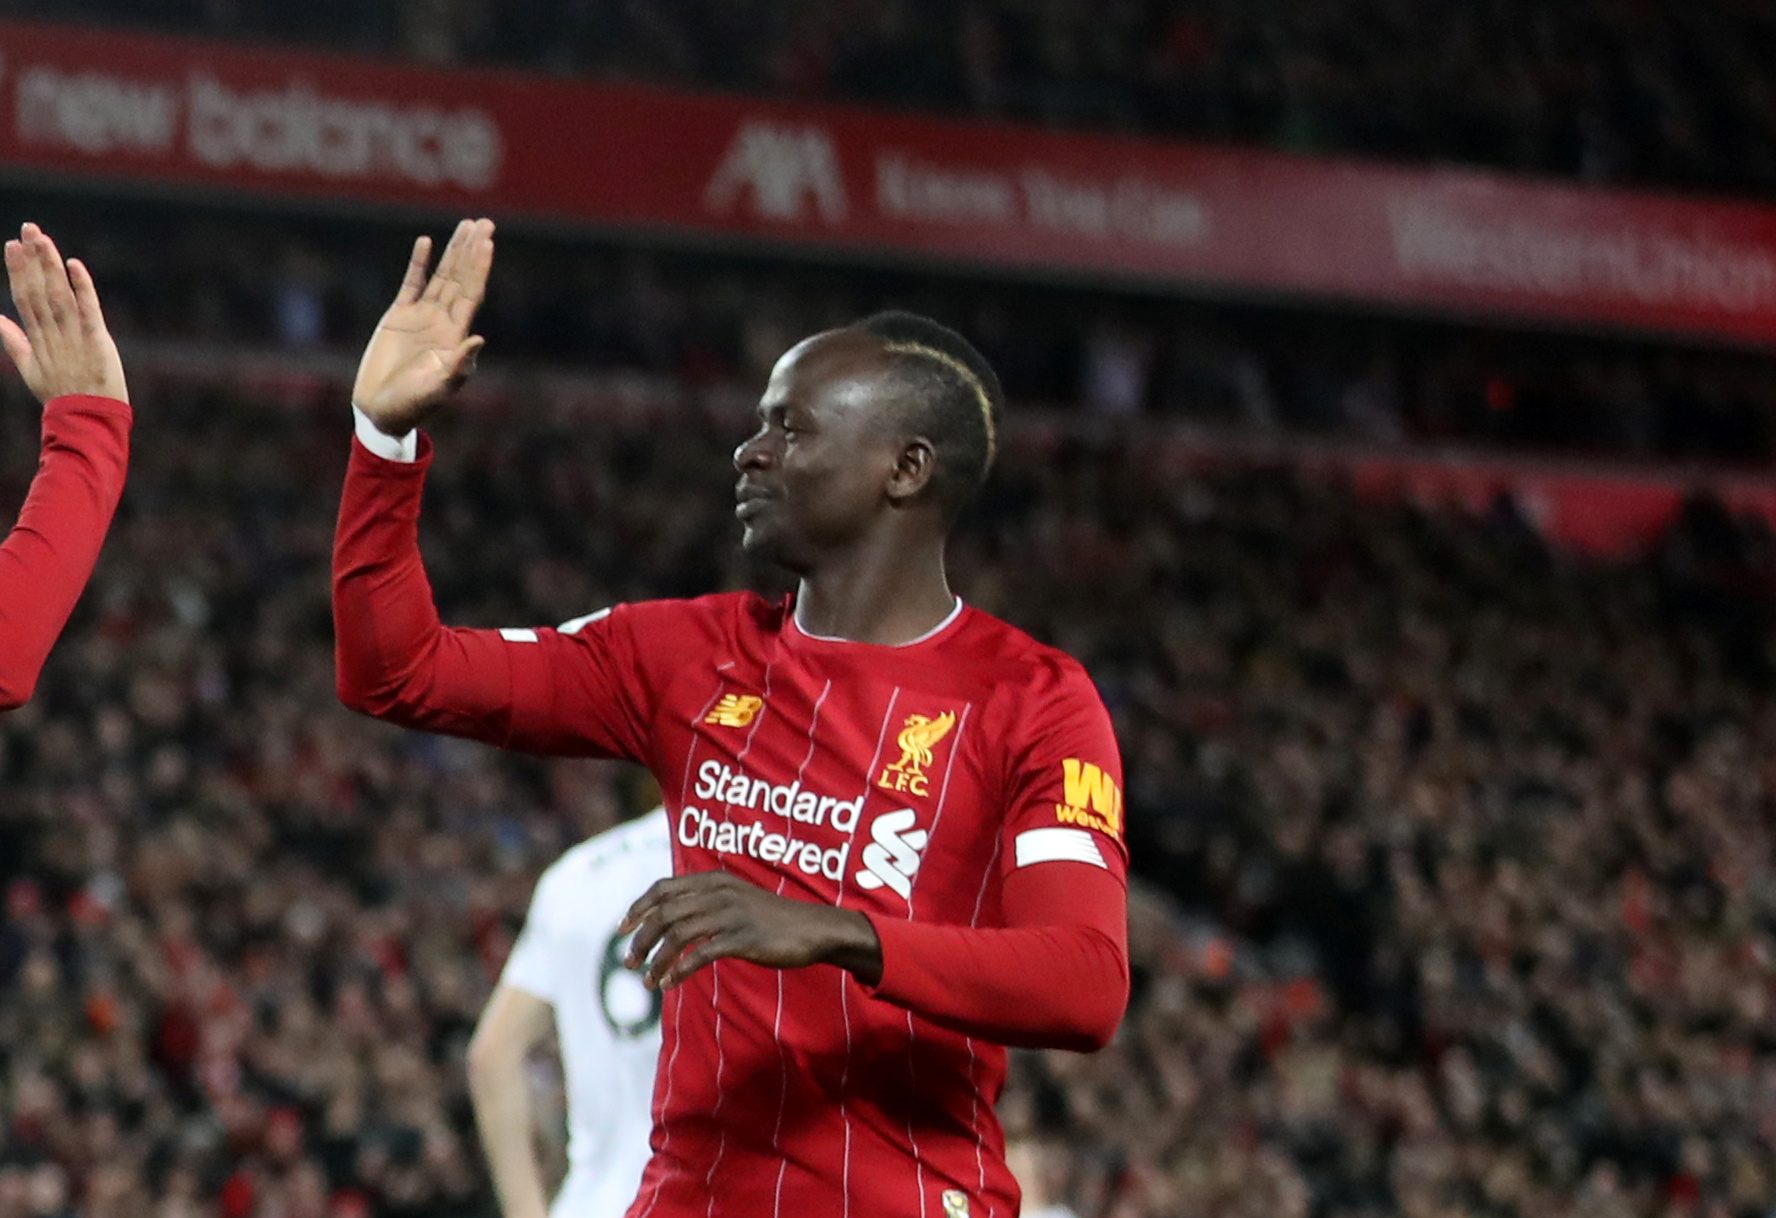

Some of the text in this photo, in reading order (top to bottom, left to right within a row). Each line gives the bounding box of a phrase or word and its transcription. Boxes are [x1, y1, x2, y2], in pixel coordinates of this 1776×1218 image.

[16, 65, 174, 152] new
[186, 68, 502, 190] balance
[694, 759, 866, 835] Standard
[678, 805, 851, 883] Chartered
